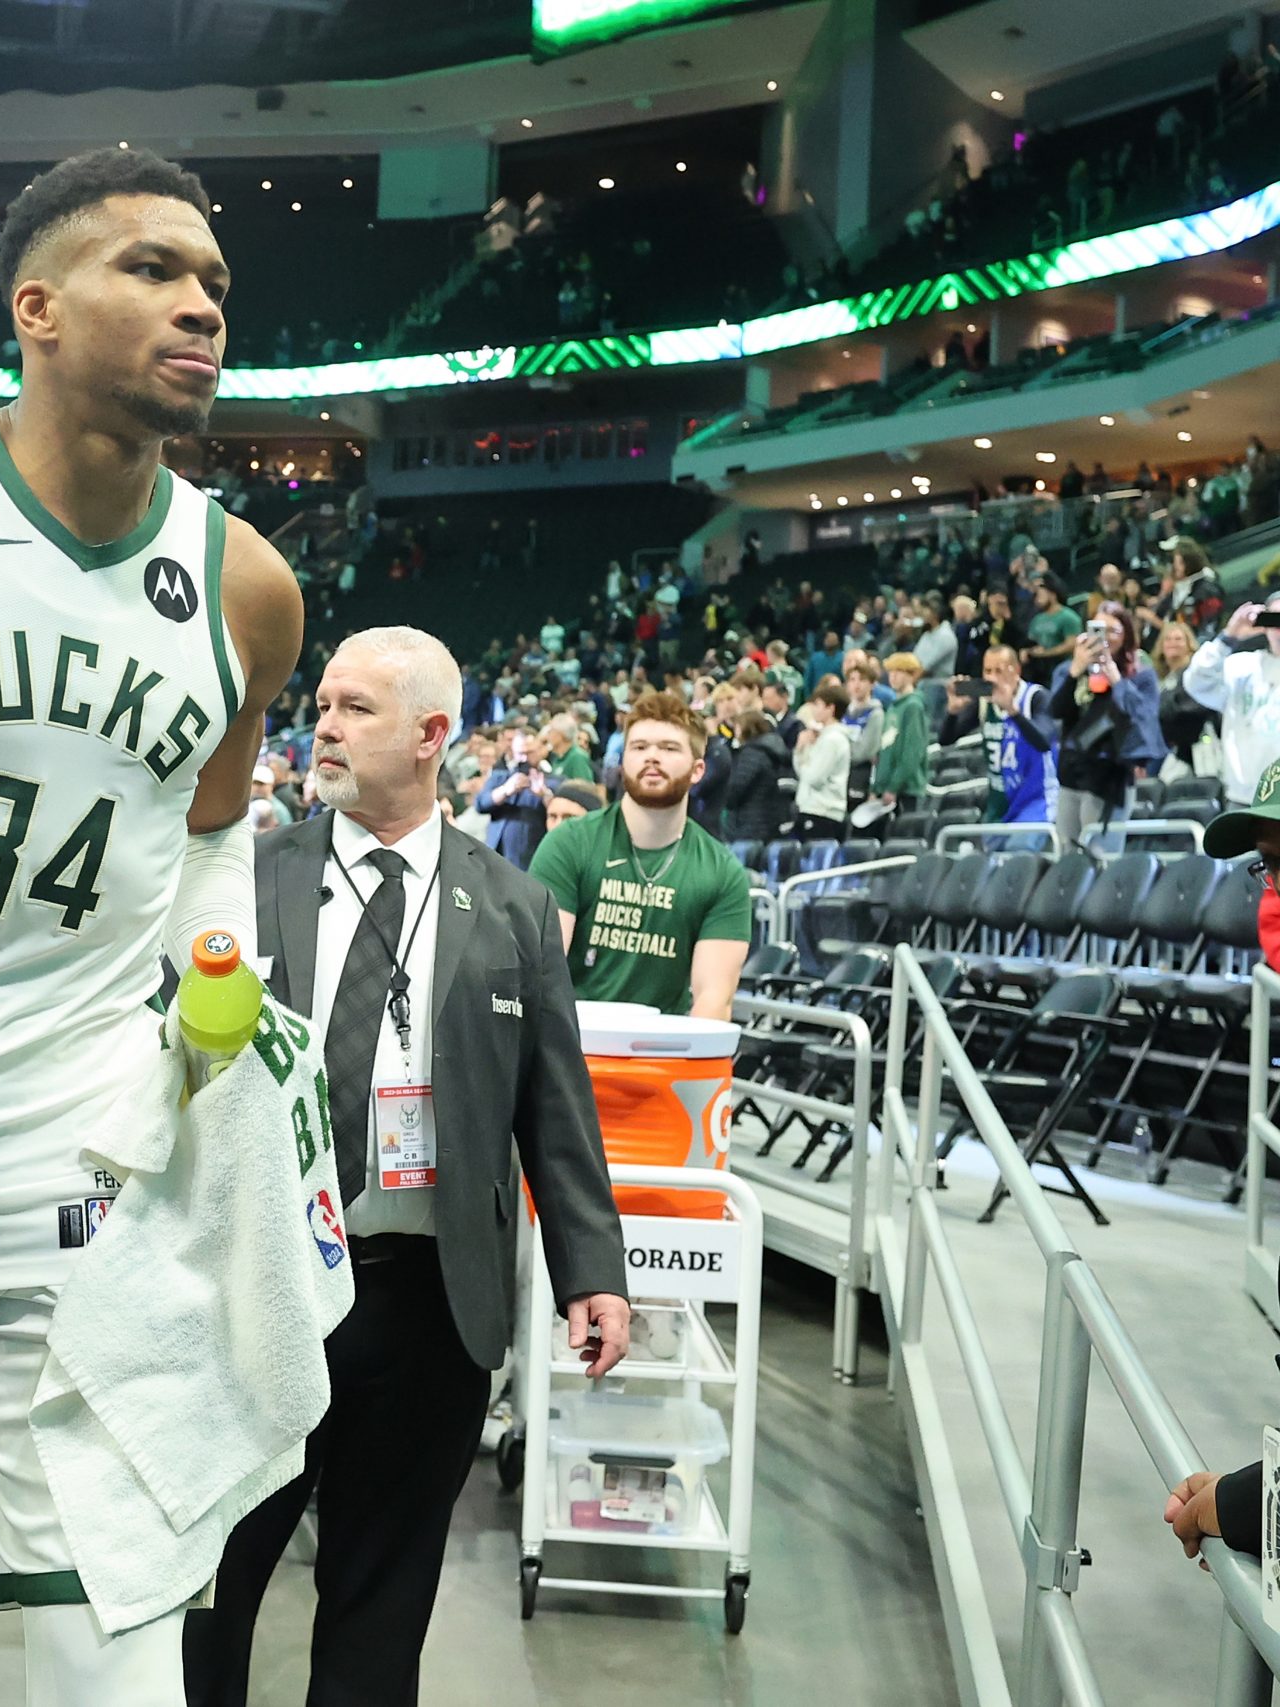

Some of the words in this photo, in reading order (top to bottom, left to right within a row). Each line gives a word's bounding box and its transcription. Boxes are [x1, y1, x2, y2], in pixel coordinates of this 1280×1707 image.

[986, 741, 1018, 771] 34
[599, 877, 676, 910] MILWAUKEE
[594, 901, 643, 929] BUCKS
[589, 925, 677, 958] BASKETBALL
[400, 1171, 427, 1181] EVENT
[624, 1248, 723, 1272] ORADE
